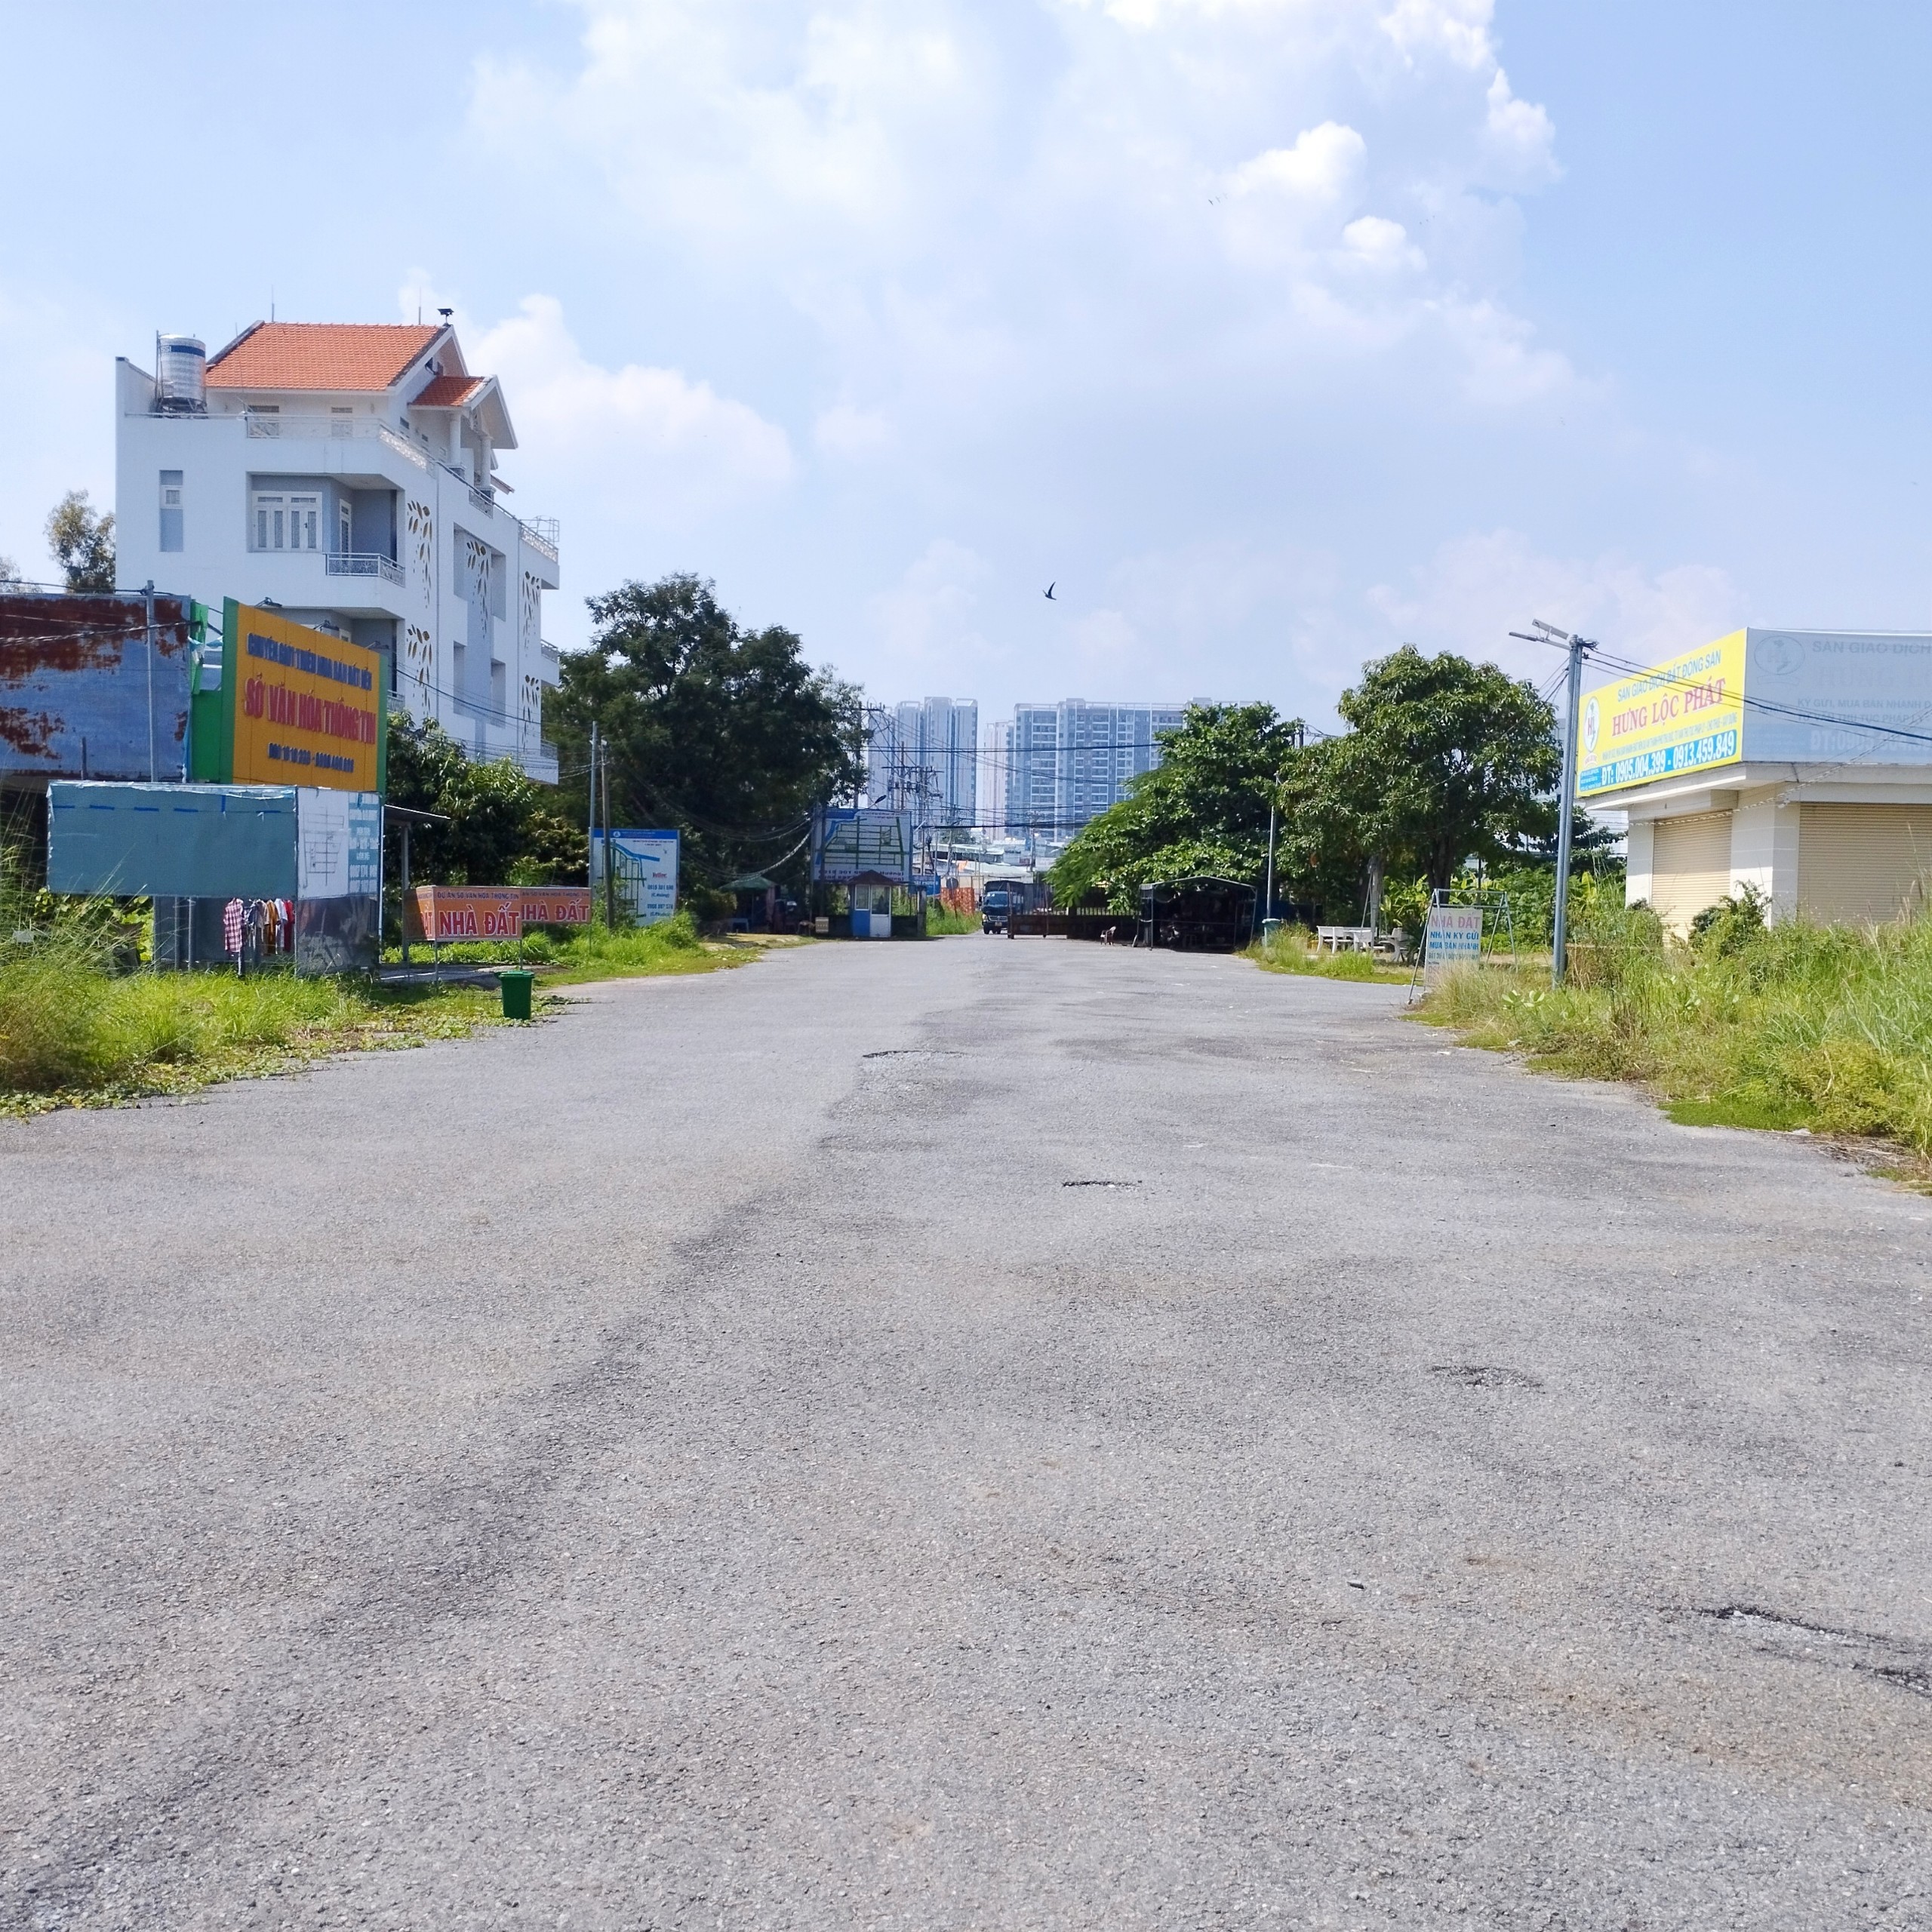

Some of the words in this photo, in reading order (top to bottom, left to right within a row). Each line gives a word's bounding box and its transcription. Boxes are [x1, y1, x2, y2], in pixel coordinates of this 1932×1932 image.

[1632, 678, 1647, 697] GIAO
[268, 682, 296, 726] VĂN
[297, 689, 322, 732] HÓA
[322, 697, 358, 741] THÔNG
[358, 708, 377, 745] TIN
[1612, 706, 1647, 737] HƯNG
[1651, 693, 1679, 727] LỘC
[1684, 675, 1726, 714] PHÁT
[1602, 764, 1614, 786] ĐT:
[1616, 749, 1666, 783] 0905.004.399
[1673, 731, 1734, 768] 0913.459.849
[439, 904, 478, 936] NHÀ
[485, 903, 519, 936] ĐẤT
[555, 900, 589, 921] ĐẤT
[1431, 912, 1454, 928] NHÀ
[1458, 912, 1481, 929] ĐẤT
